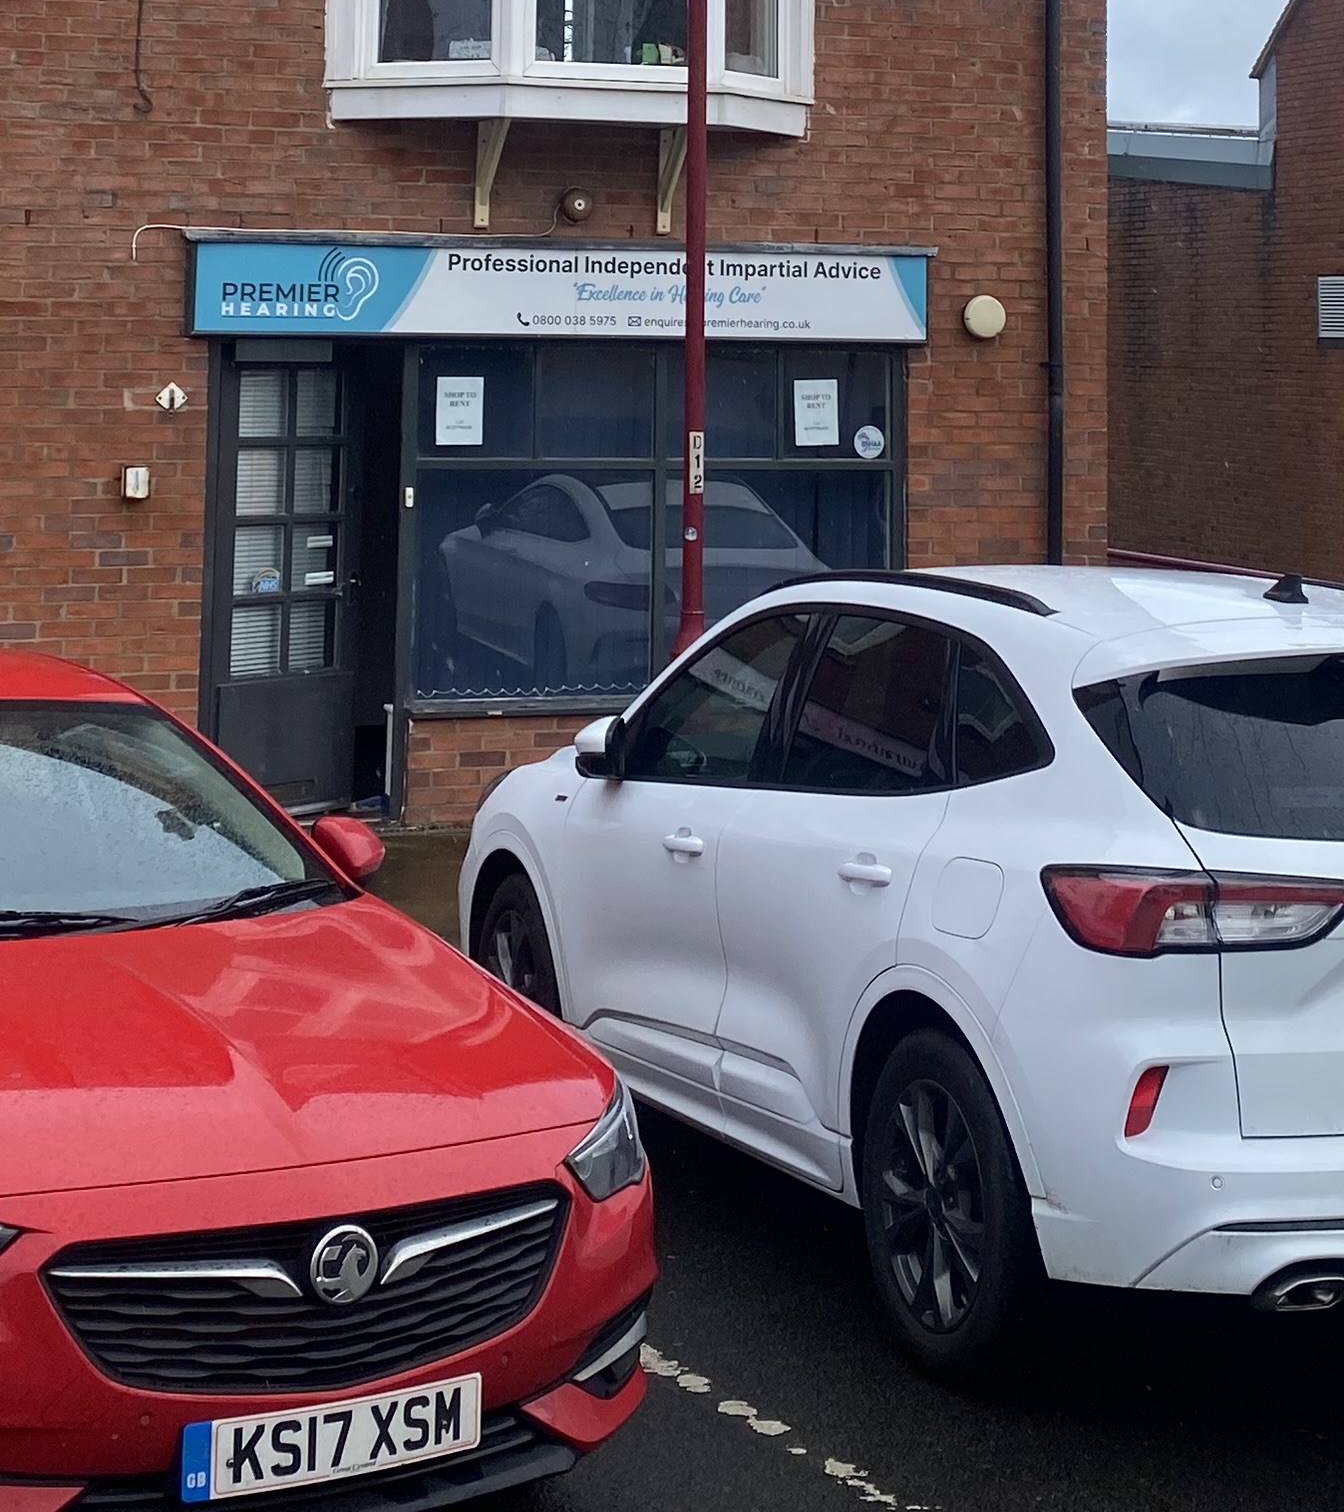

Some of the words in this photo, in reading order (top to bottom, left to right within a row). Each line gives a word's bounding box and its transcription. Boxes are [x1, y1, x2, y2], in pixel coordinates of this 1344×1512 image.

[447, 253, 578, 274] Professional
[584, 256, 715, 279] Independt
[720, 258, 808, 281] Impartial
[813, 261, 882, 280] Advice
[221, 282, 340, 303] PREMIER
[650, 287, 665, 302] in
[667, 284, 725, 309] Hing
[220, 301, 337, 318] HEARING
[532, 315, 562, 326] 0800
[564, 315, 587, 326] 038
[589, 316, 617, 327] 5975
[260, 579, 277, 589] NHS
[230, 1409, 354, 1485] KS17
[368, 1386, 462, 1462] XSM
[186, 1471, 207, 1489] GB
